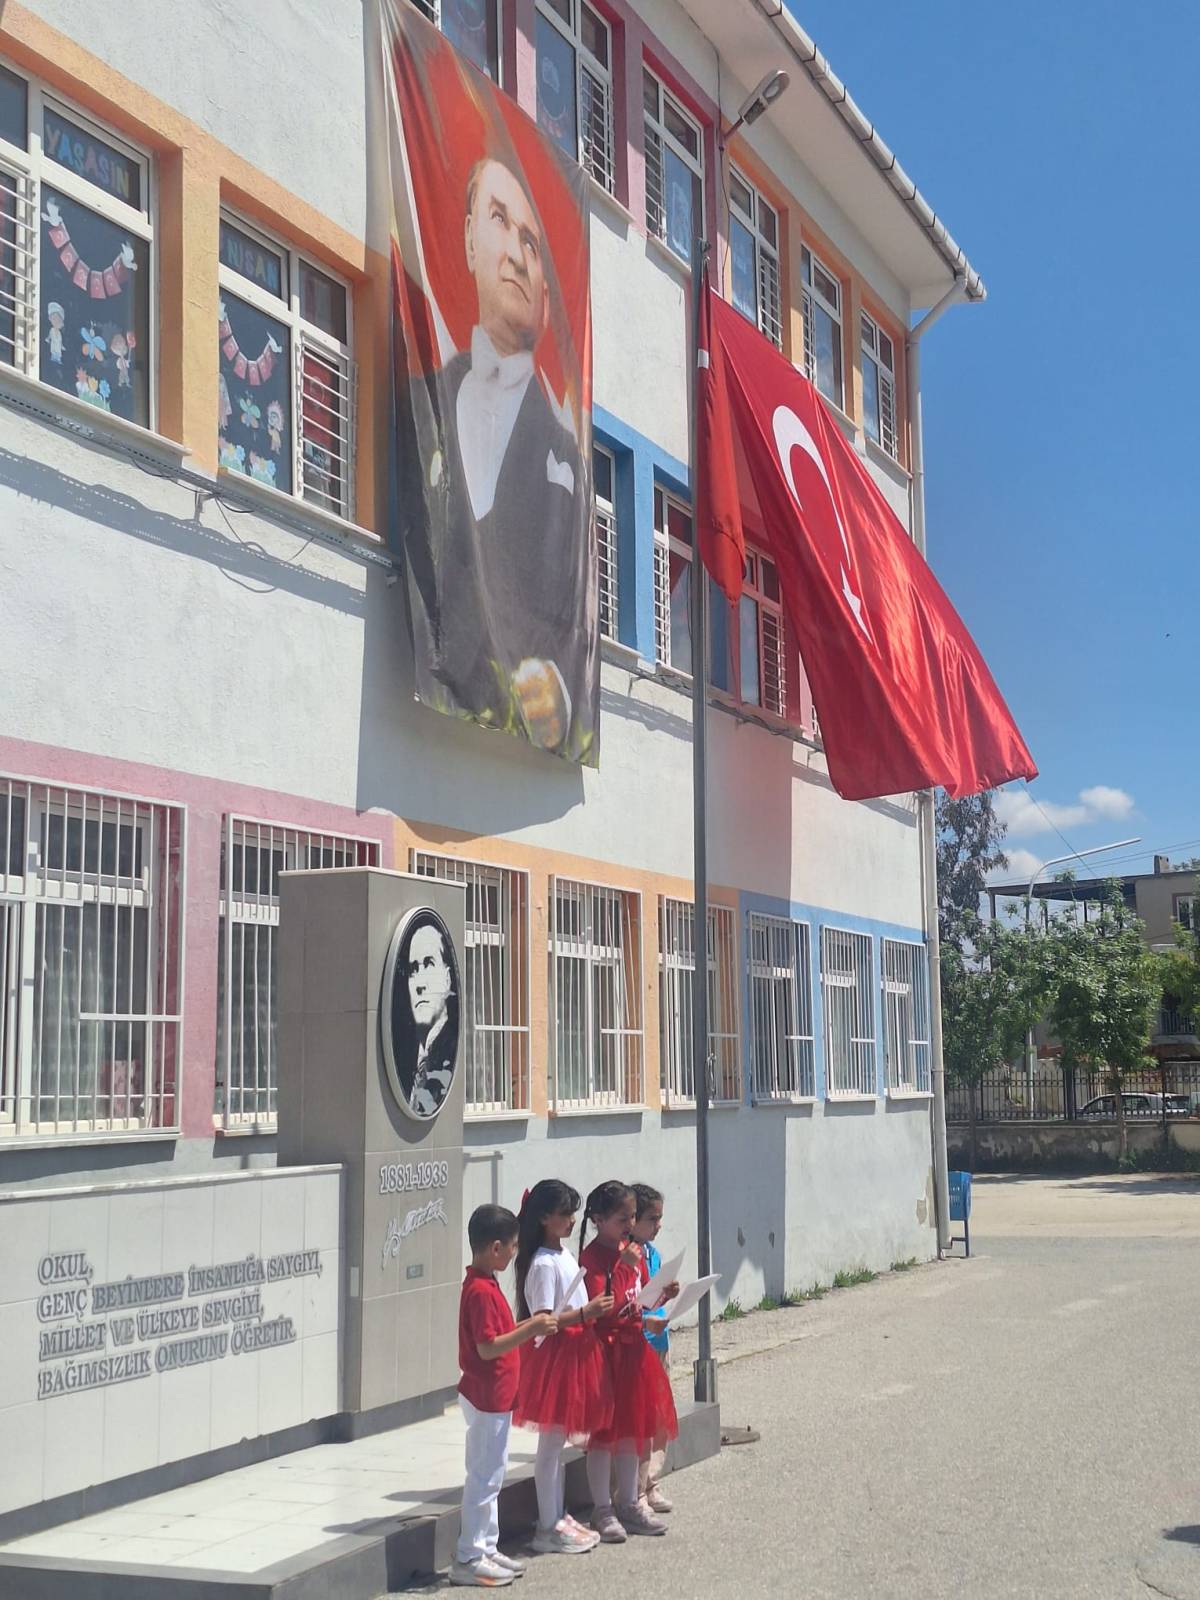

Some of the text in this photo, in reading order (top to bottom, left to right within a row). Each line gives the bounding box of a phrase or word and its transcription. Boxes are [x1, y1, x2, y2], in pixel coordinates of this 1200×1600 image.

[380, 1161, 449, 1193] 1881-1938
[38, 1250, 323, 1322] GENÇ BEYİNLERE İNSANLIĞA SAYGIYI,
[39, 1253, 93, 1285] OKUL,
[39, 1288, 264, 1361] MİLLET VE ÜLKEYE SEVGİYİ,
[38, 1351, 151, 1399] BAĞIMSIZLIK
[155, 1333, 229, 1372] ONURUNU
